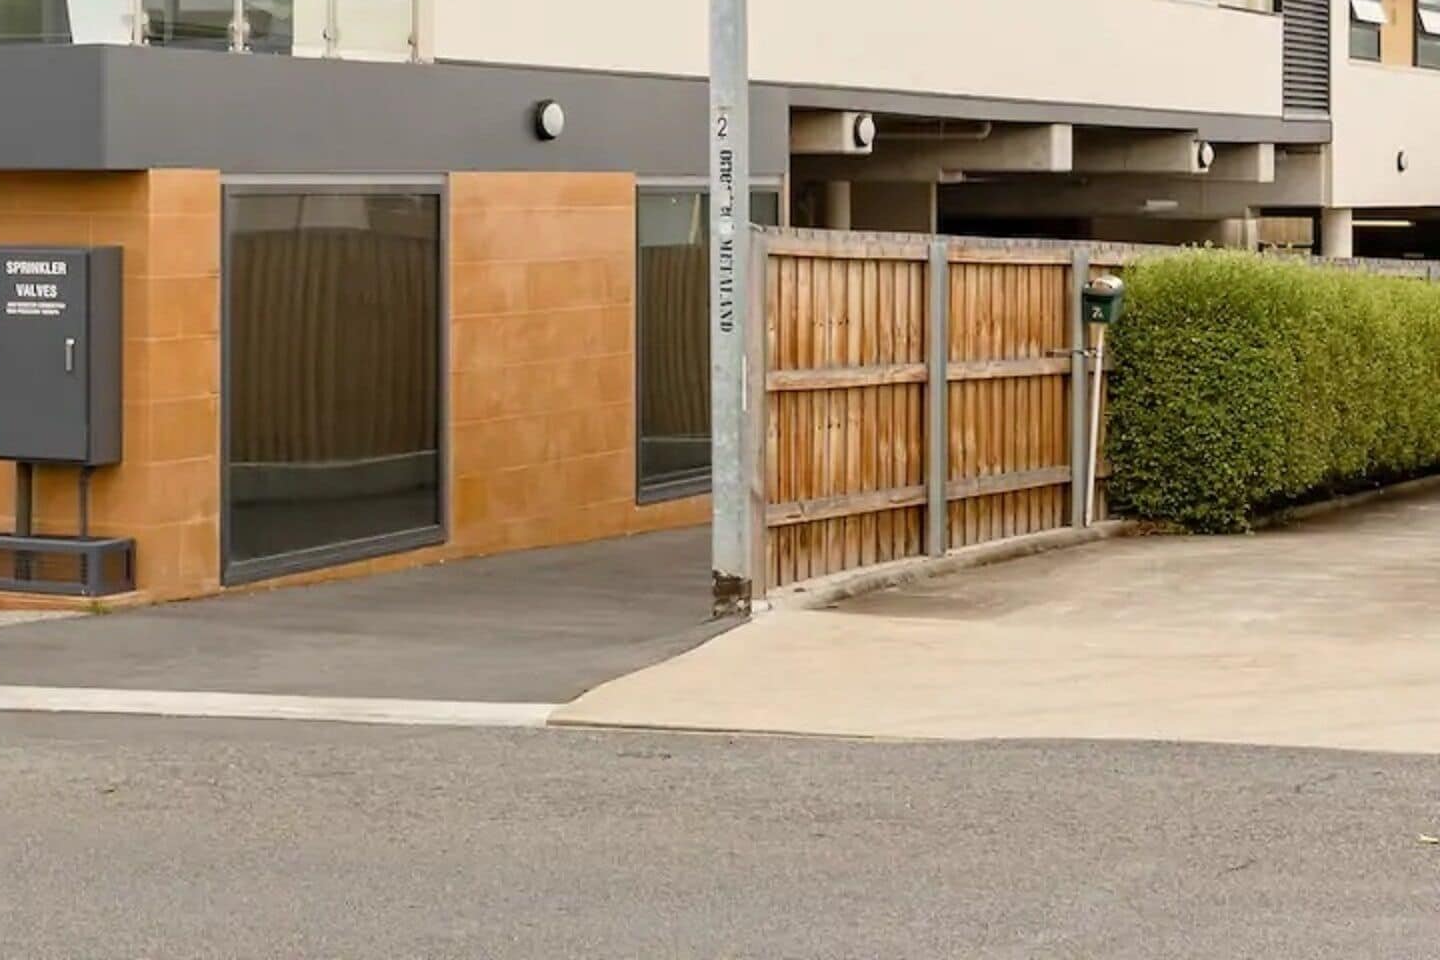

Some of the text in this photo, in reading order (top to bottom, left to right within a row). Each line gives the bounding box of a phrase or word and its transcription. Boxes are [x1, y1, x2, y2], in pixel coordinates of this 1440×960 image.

[717, 117, 727, 137] 2
[6, 260, 67, 275] SPRINKLER
[15, 283, 58, 298] VALVES
